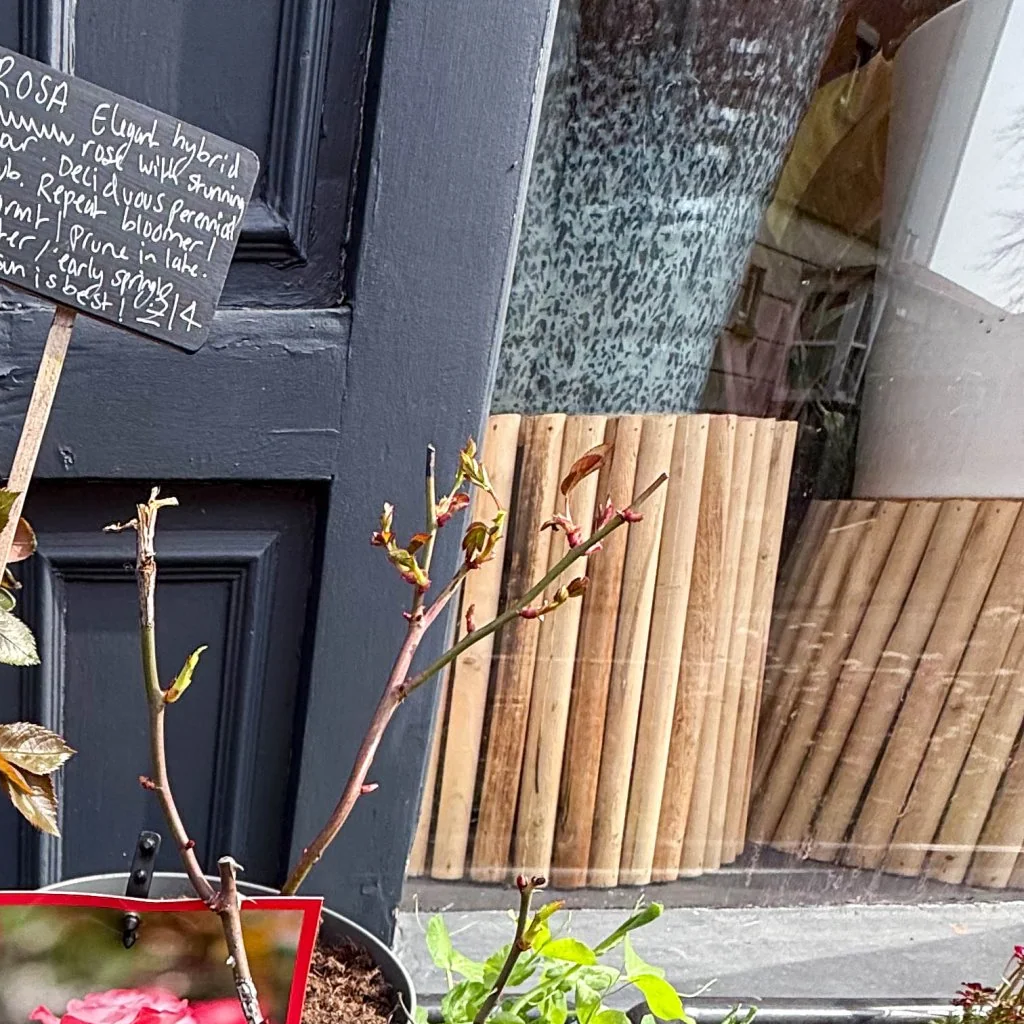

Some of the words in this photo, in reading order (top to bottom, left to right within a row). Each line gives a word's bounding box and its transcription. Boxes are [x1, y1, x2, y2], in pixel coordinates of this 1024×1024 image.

[91, 103, 159, 156] Elegant
[172, 123, 240, 179] hybrid
[36, 172, 107, 220] Repeat
[57, 252, 104, 290] early
[139, 241, 157, 264] in
[34, 265, 58, 289] is
